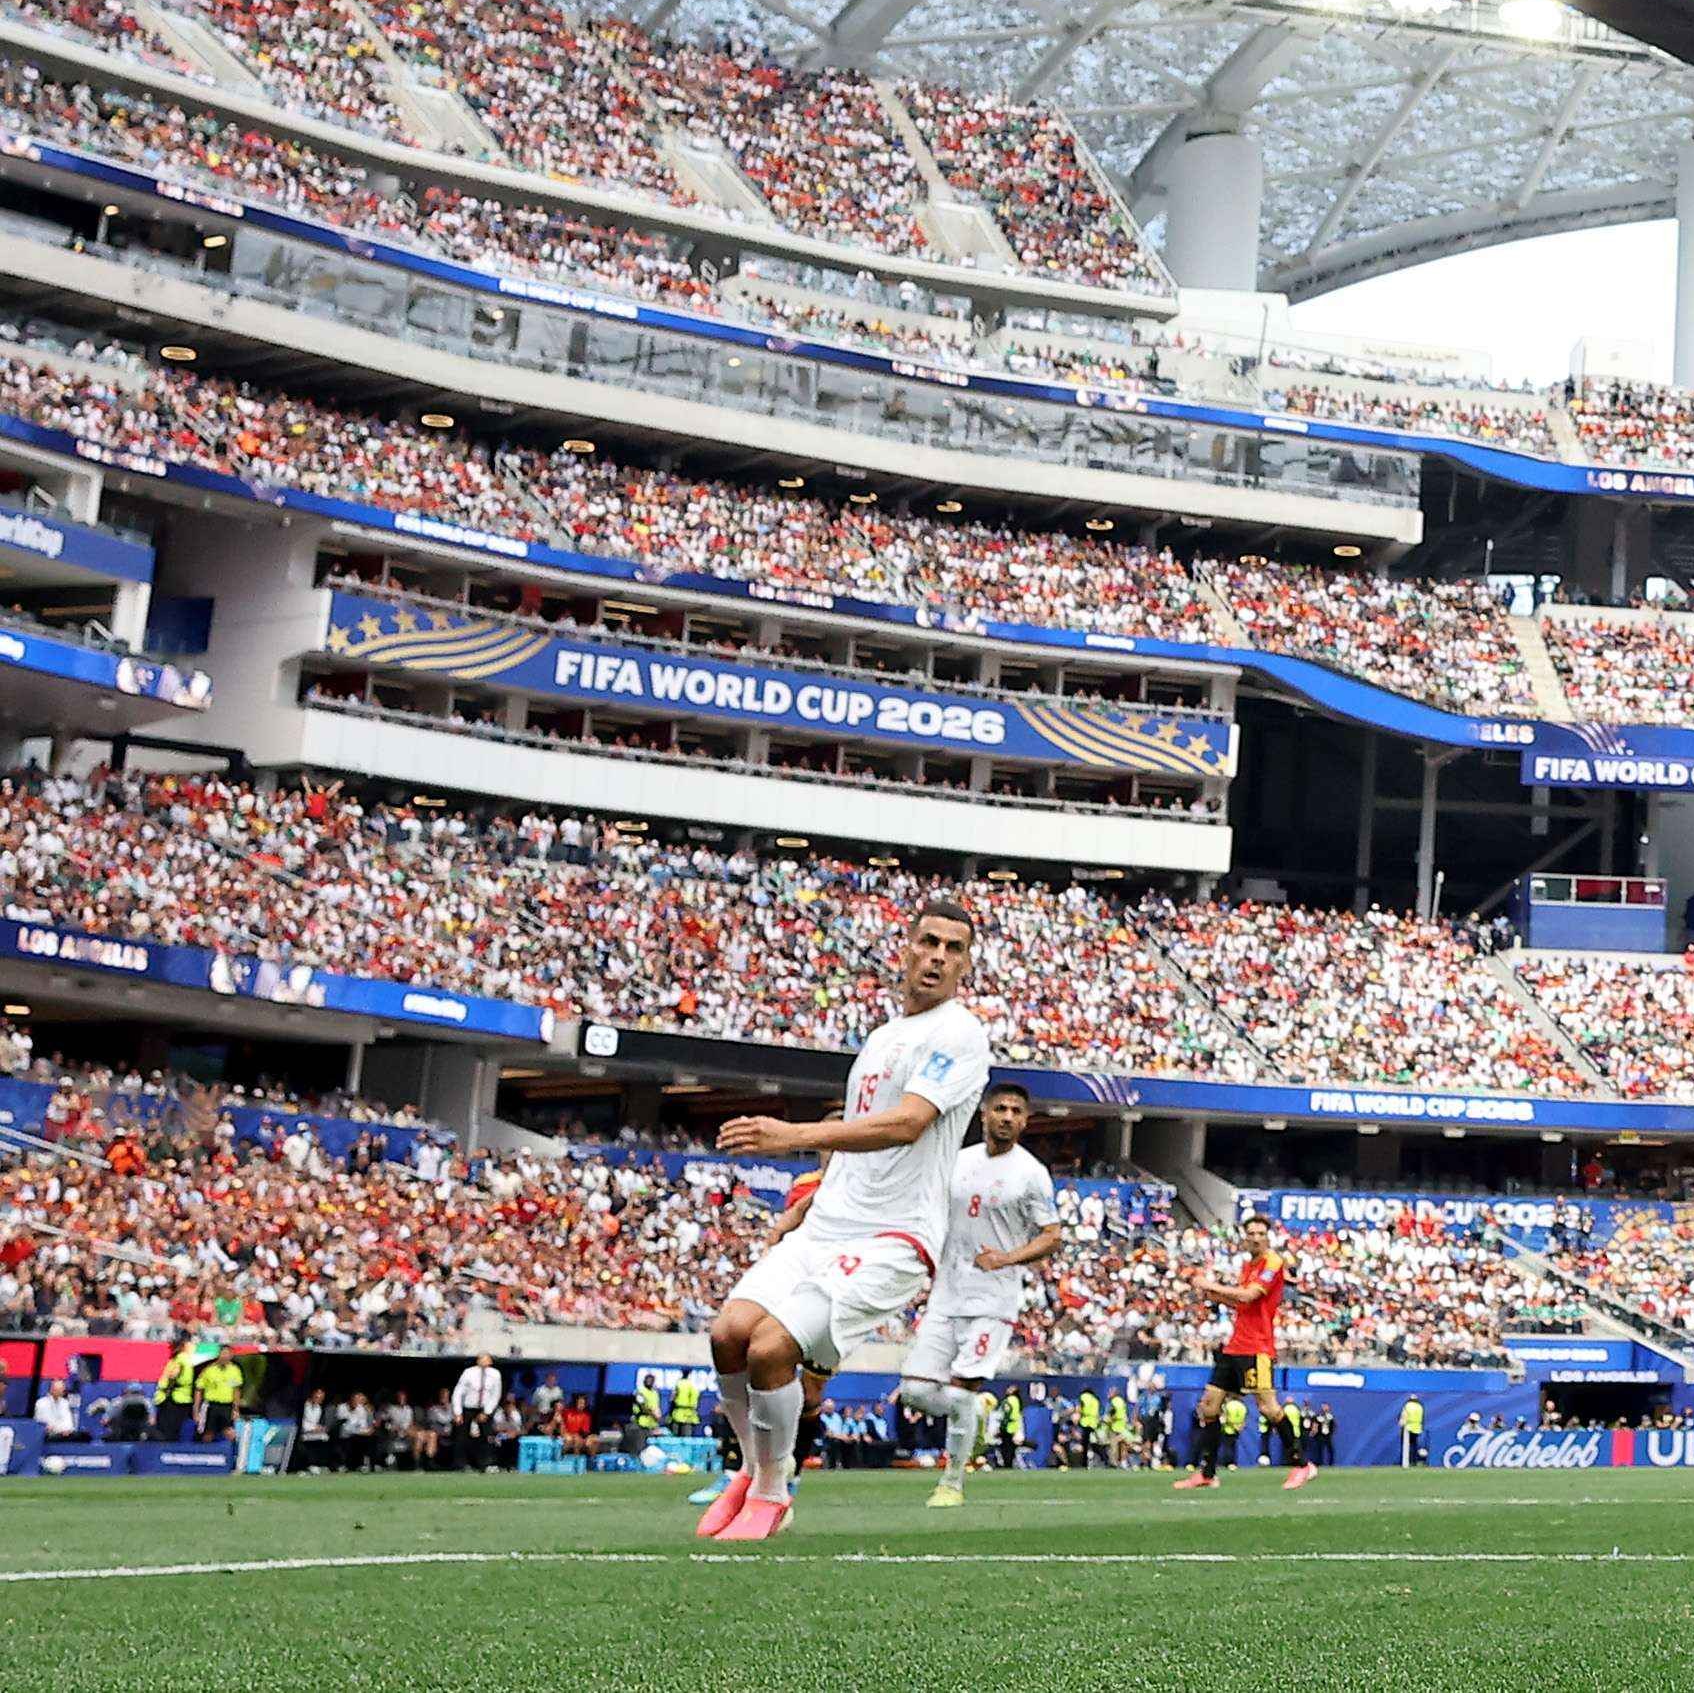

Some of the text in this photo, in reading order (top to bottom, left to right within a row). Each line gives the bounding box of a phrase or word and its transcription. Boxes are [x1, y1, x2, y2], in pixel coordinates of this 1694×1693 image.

[555, 650, 1005, 744] FIFA WORLD CUP 2026
[1535, 757, 1592, 781] FIFA
[1593, 759, 1689, 785] WORLD
[1281, 1195, 1340, 1221] FIFA
[1443, 1428, 1601, 1467] Michelob
